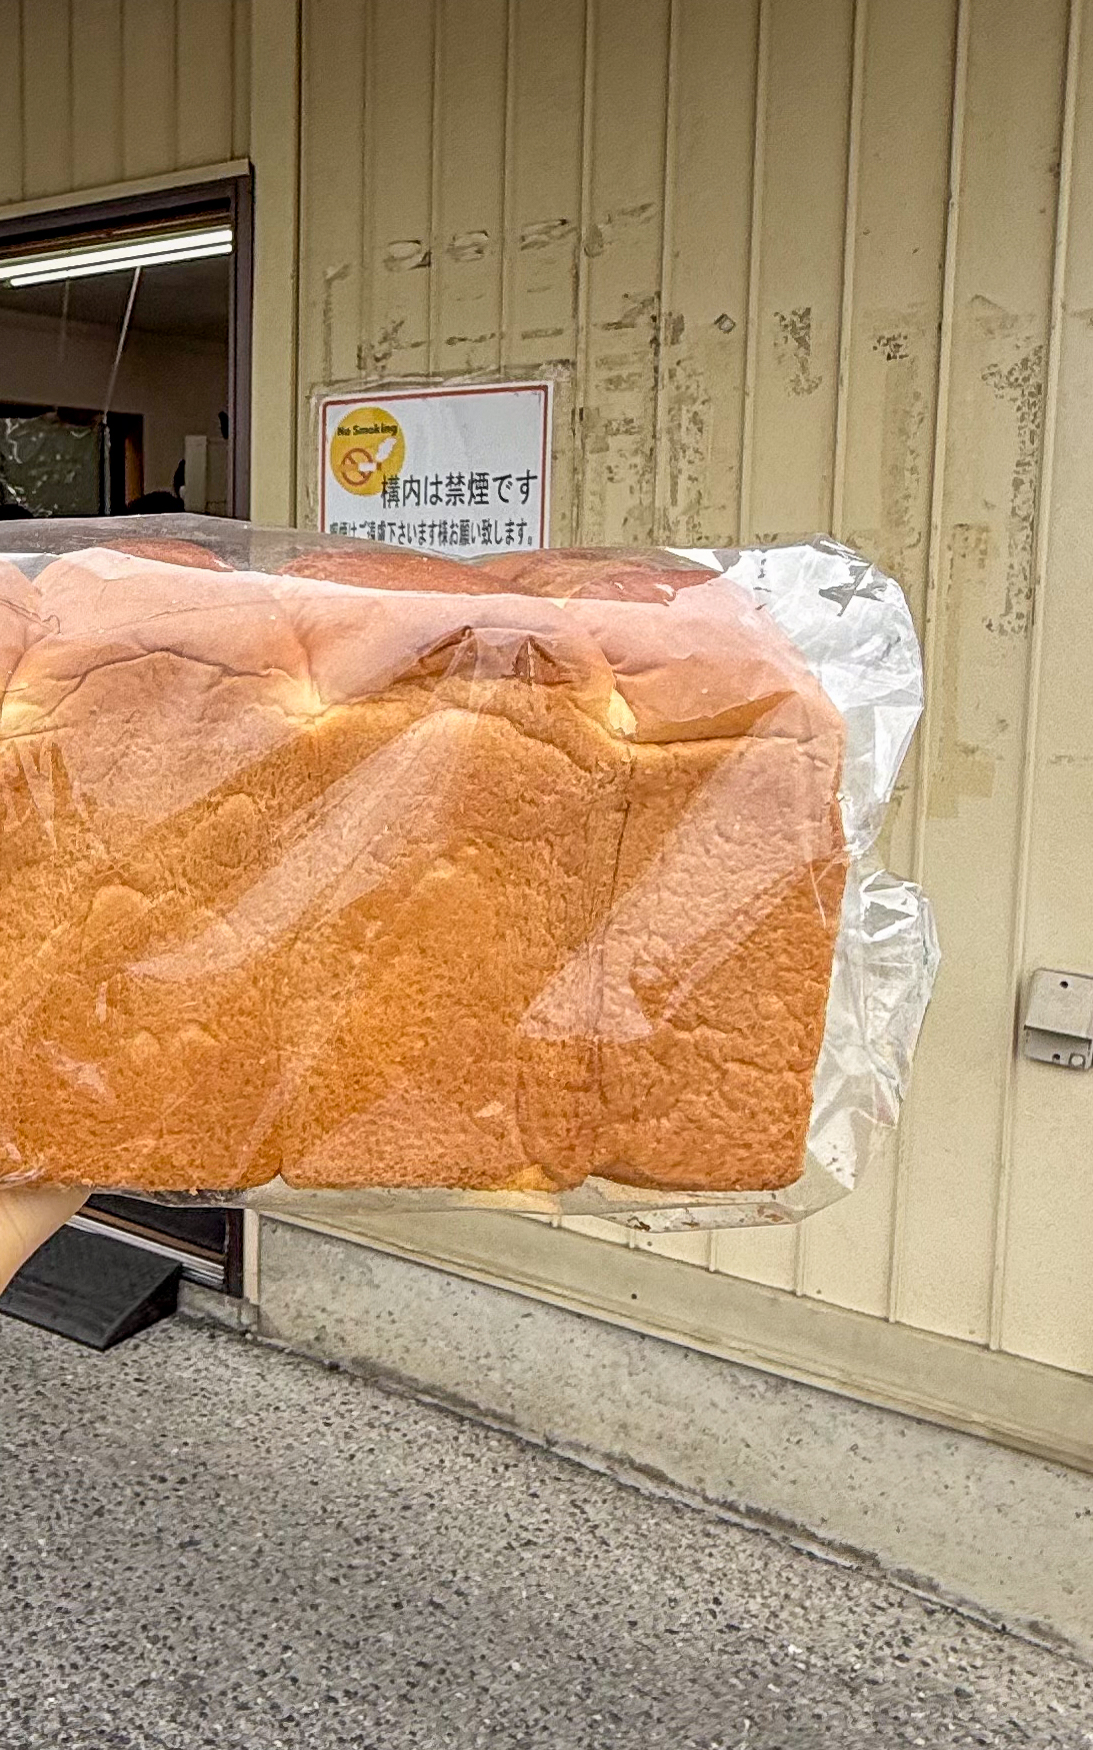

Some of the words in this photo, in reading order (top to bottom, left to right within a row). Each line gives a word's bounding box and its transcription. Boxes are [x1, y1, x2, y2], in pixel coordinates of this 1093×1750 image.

[337, 426, 351, 436] No
[353, 423, 398, 436] Smoking
[381, 469, 538, 508] 構内は禁煙です
